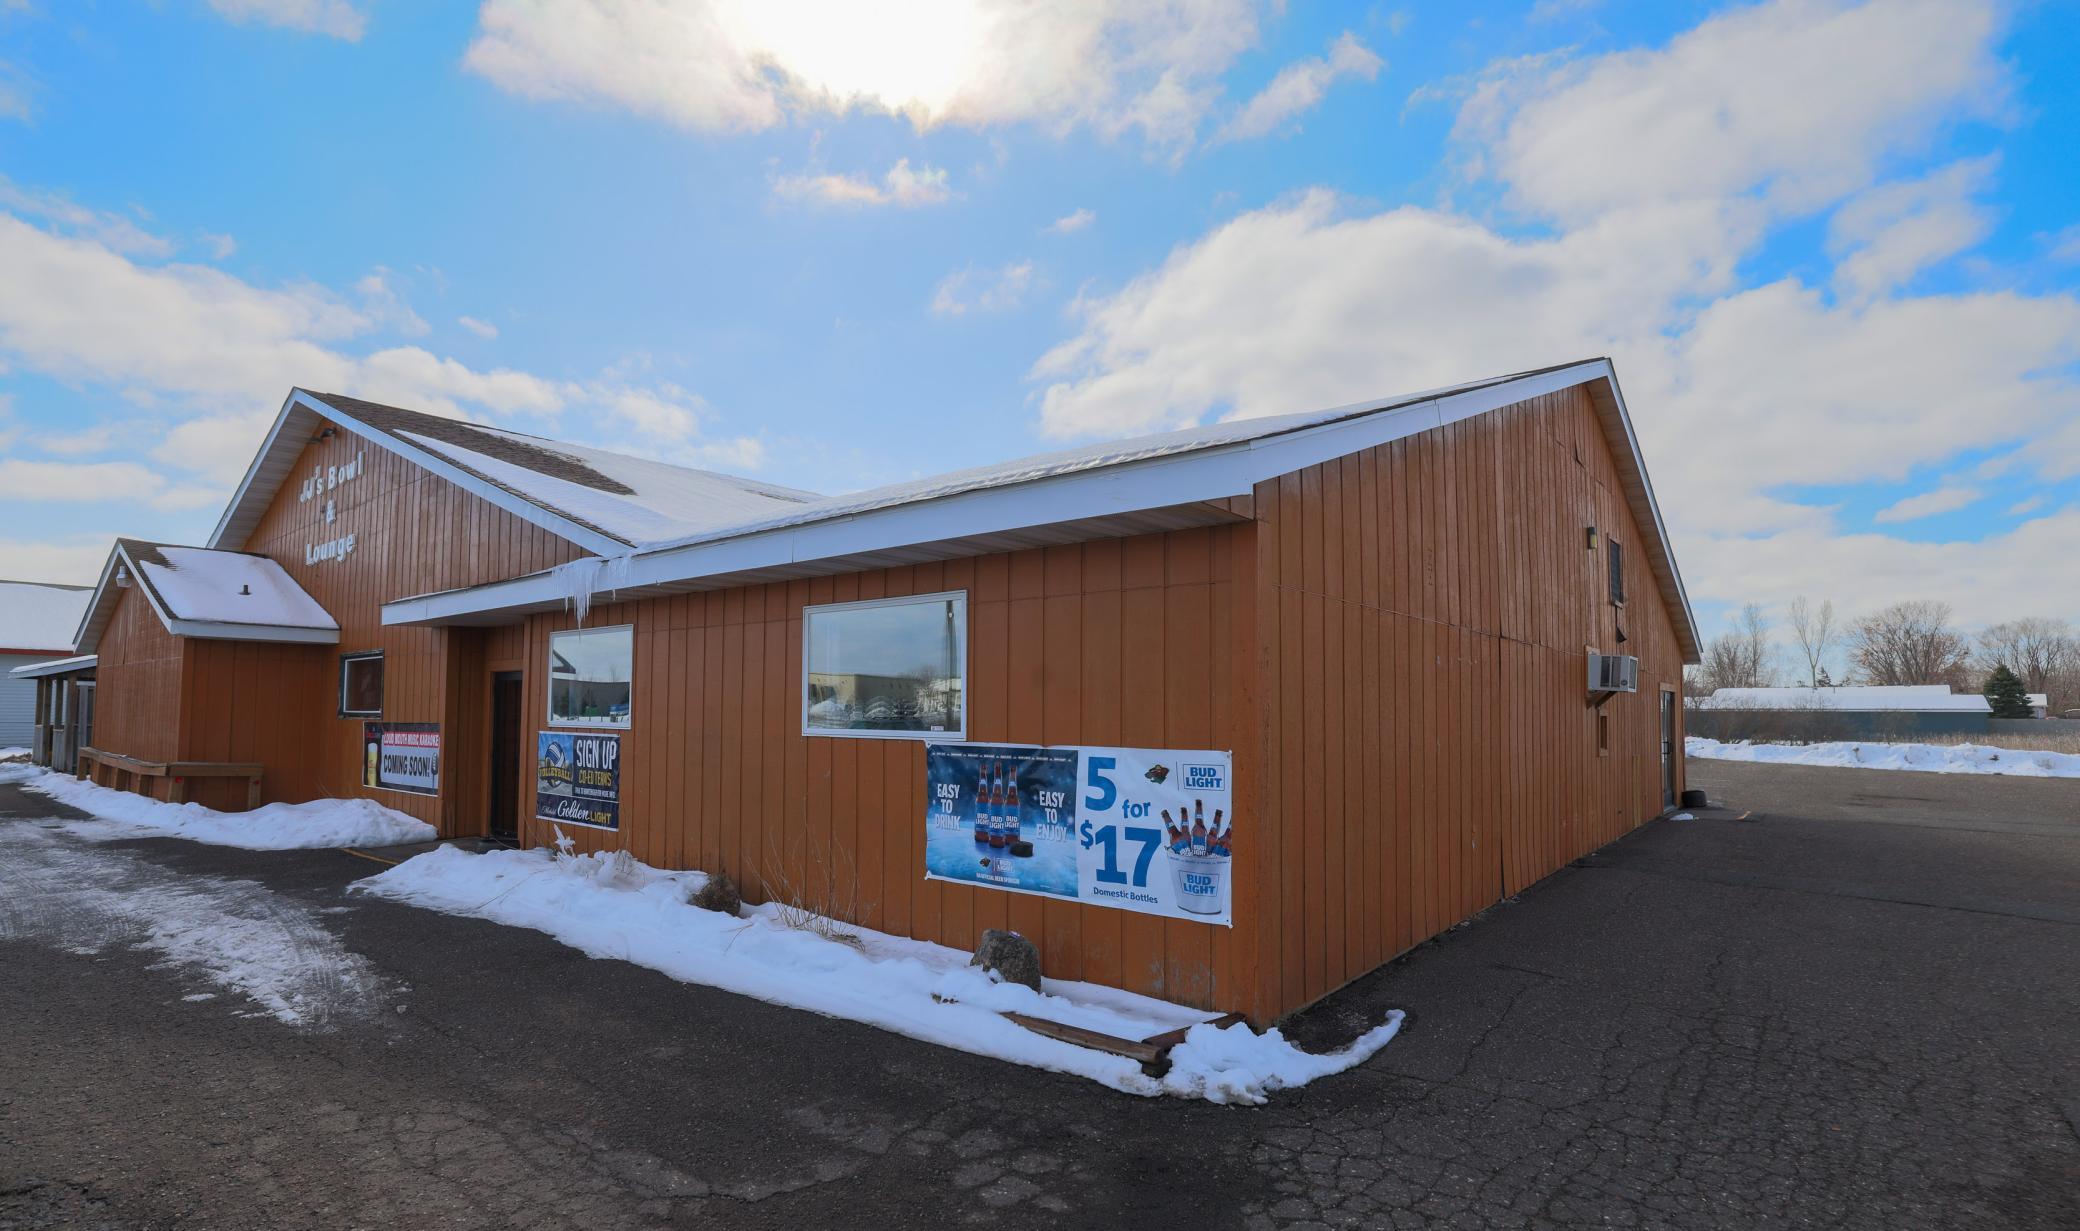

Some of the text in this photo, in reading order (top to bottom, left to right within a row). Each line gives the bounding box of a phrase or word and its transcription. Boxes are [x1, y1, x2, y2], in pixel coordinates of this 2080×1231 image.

[300, 451, 365, 503] JJ's Bowl
[326, 500, 336, 524] &
[305, 533, 356, 566] Lounge
[576, 739, 617, 770] SIGN UP
[384, 754, 431, 778] COMING SOON!
[539, 767, 571, 781] VOLLEYBALL
[1189, 766, 1217, 778] BUD
[937, 783, 960, 799] EASY
[1085, 756, 1117, 811] 5
[1185, 776, 1223, 789] LIGHT
[940, 799, 953, 814] TO
[1039, 790, 1065, 808] EASY
[557, 800, 590, 820] Golden
[590, 811, 612, 825] LIGHT
[1044, 808, 1058, 824] TO
[1121, 799, 1151, 819] for
[935, 813, 961, 831] DRINK
[989, 822, 1005, 830] LIGHT
[990, 815, 1003, 823] BUD
[1004, 821, 1020, 829] LIGHT
[1005, 815, 1018, 823] BUD
[1036, 824, 1068, 842] ENJOY
[1080, 819, 1162, 888] $17
[1186, 872, 1212, 885] BUD
[1093, 886, 1159, 904] Domestic Bottles
[1183, 882, 1216, 895] LIGHT
